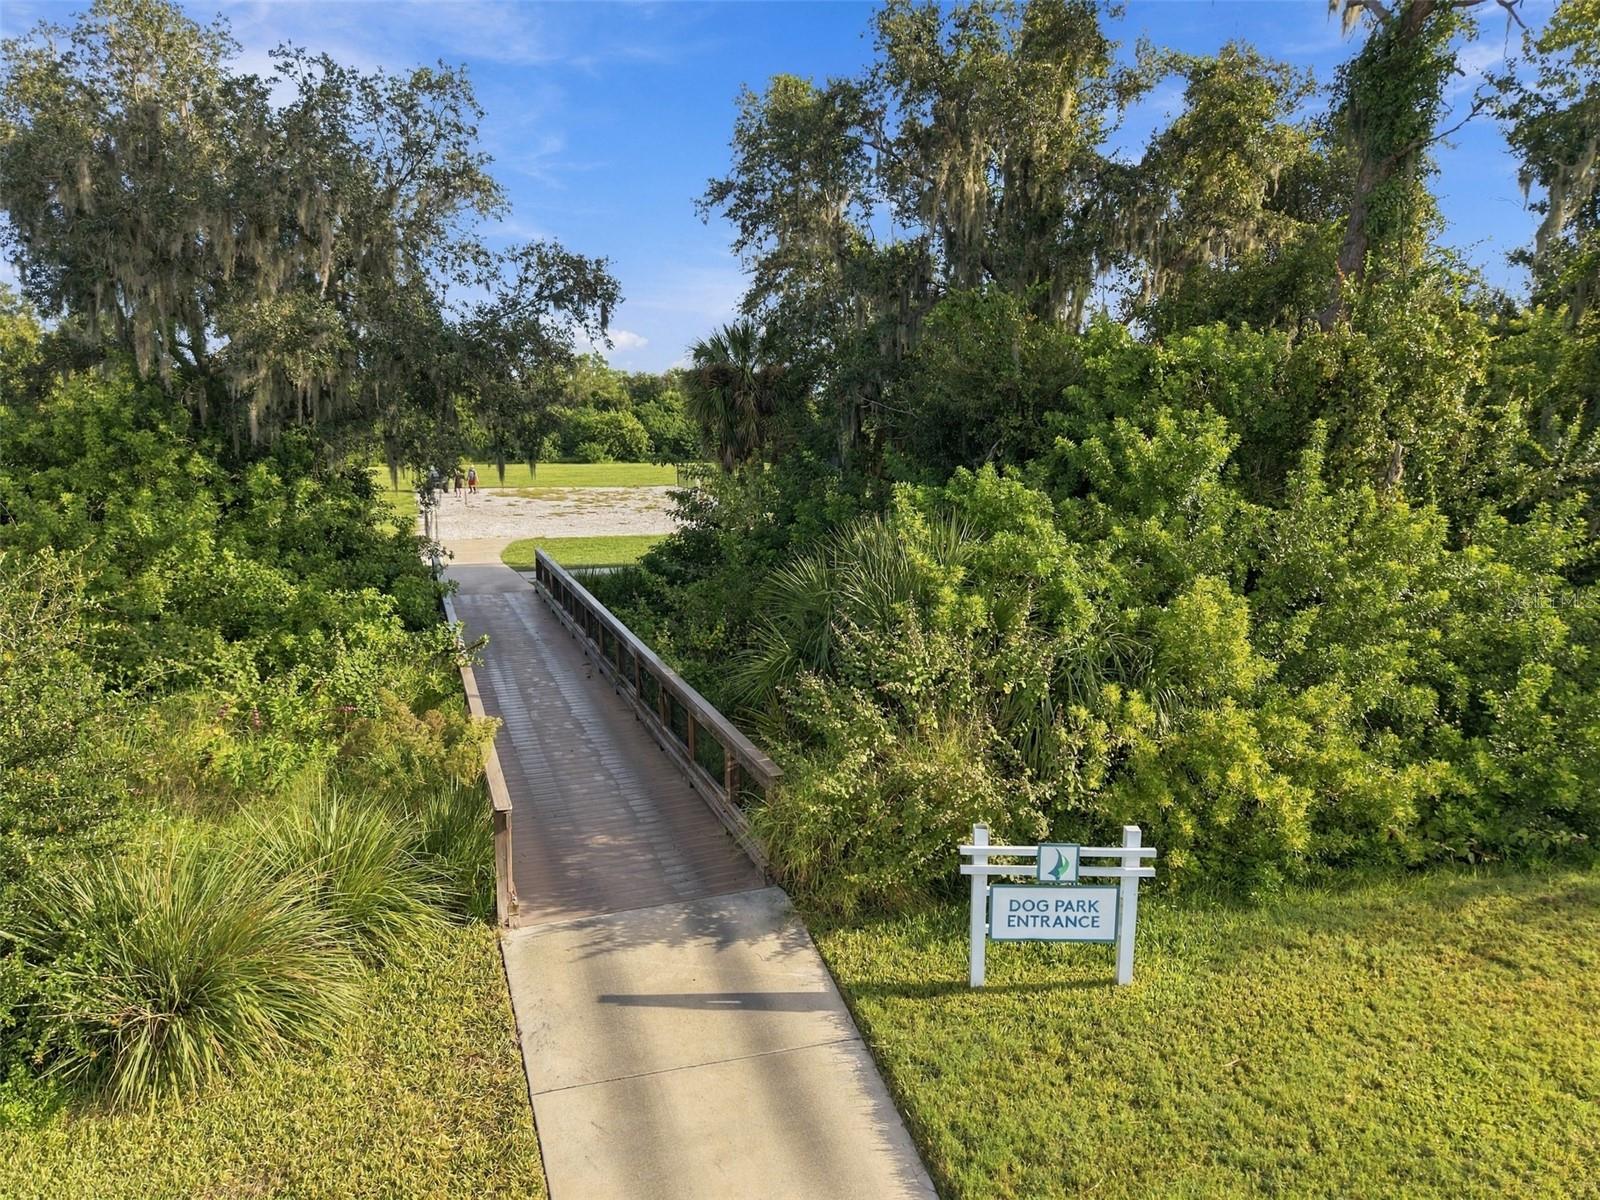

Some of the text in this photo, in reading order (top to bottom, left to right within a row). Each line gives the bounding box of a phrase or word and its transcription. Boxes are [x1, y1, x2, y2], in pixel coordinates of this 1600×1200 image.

[1009, 899, 1100, 913] DOG PARK
[1007, 914, 1101, 928] ENTRANCE
